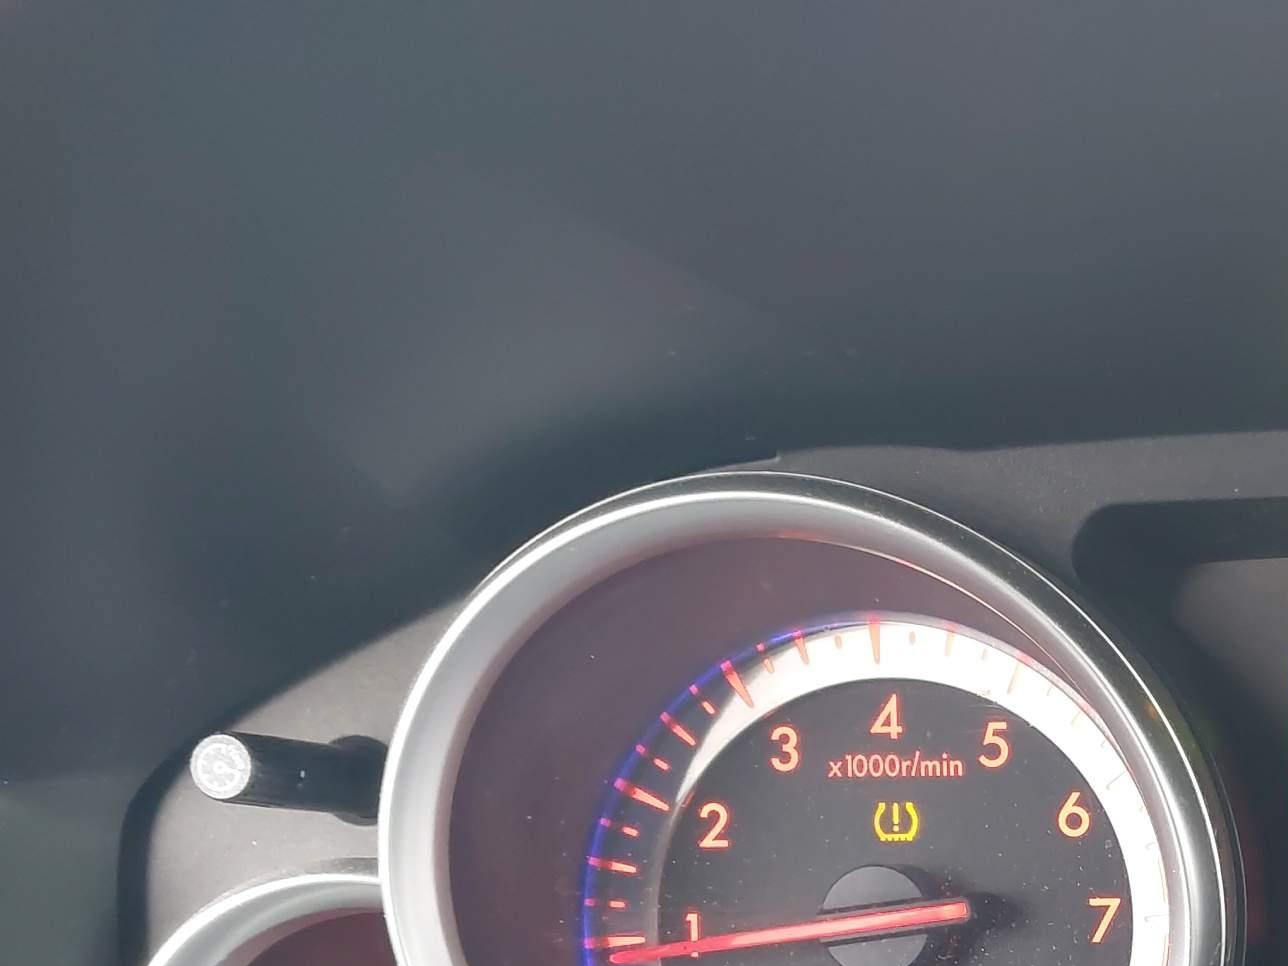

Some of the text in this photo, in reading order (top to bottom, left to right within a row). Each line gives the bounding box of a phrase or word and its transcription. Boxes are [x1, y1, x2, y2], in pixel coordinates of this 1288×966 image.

[869, 693, 902, 739] 4
[771, 726, 800, 772] 3
[827, 749, 964, 778] x1000r/min
[978, 722, 1009, 768] 5
[701, 803, 729, 848] 2
[1058, 792, 1091, 837] 6
[685, 913, 699, 957] 1
[1089, 898, 1121, 943] 7
